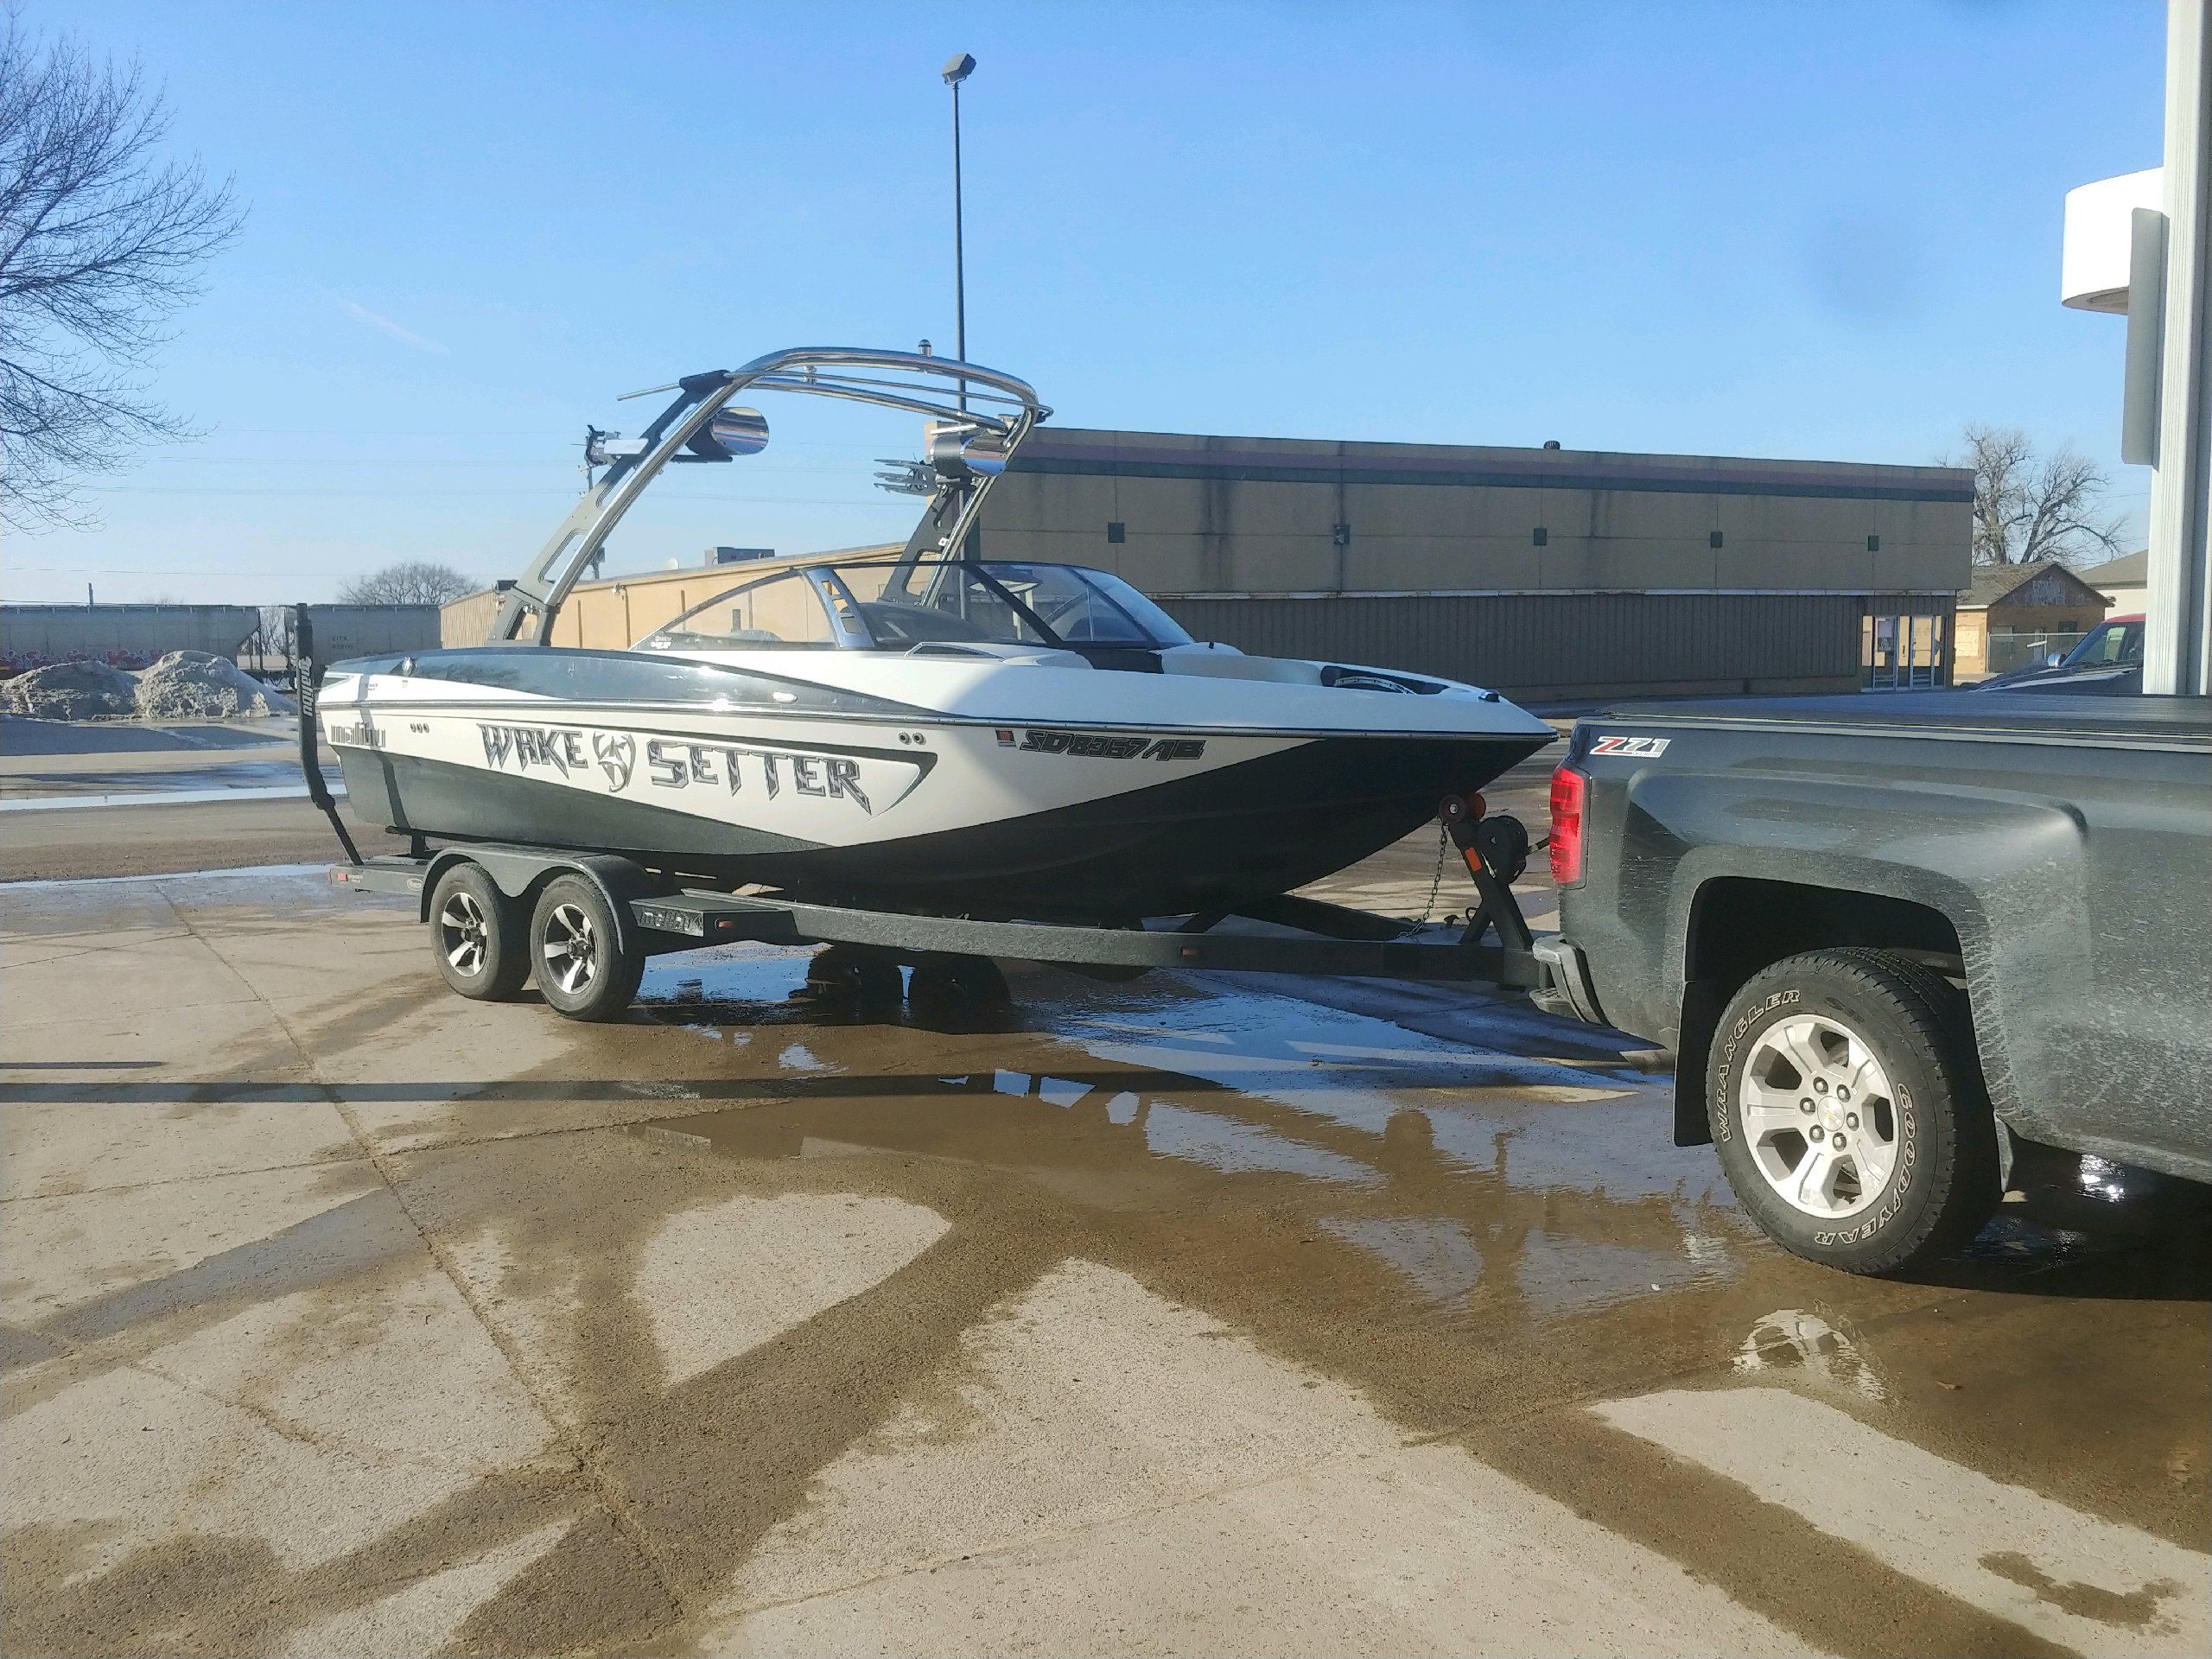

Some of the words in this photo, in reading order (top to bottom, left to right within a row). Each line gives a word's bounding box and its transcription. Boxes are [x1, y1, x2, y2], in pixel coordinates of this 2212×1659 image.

[476, 723, 588, 779] WAKE
[647, 739, 872, 816] SETTER
[1589, 736, 1673, 758] Z71
[1714, 989, 1801, 1142] WRANGLER
[1815, 1084, 1916, 1246] GOODYEAR
